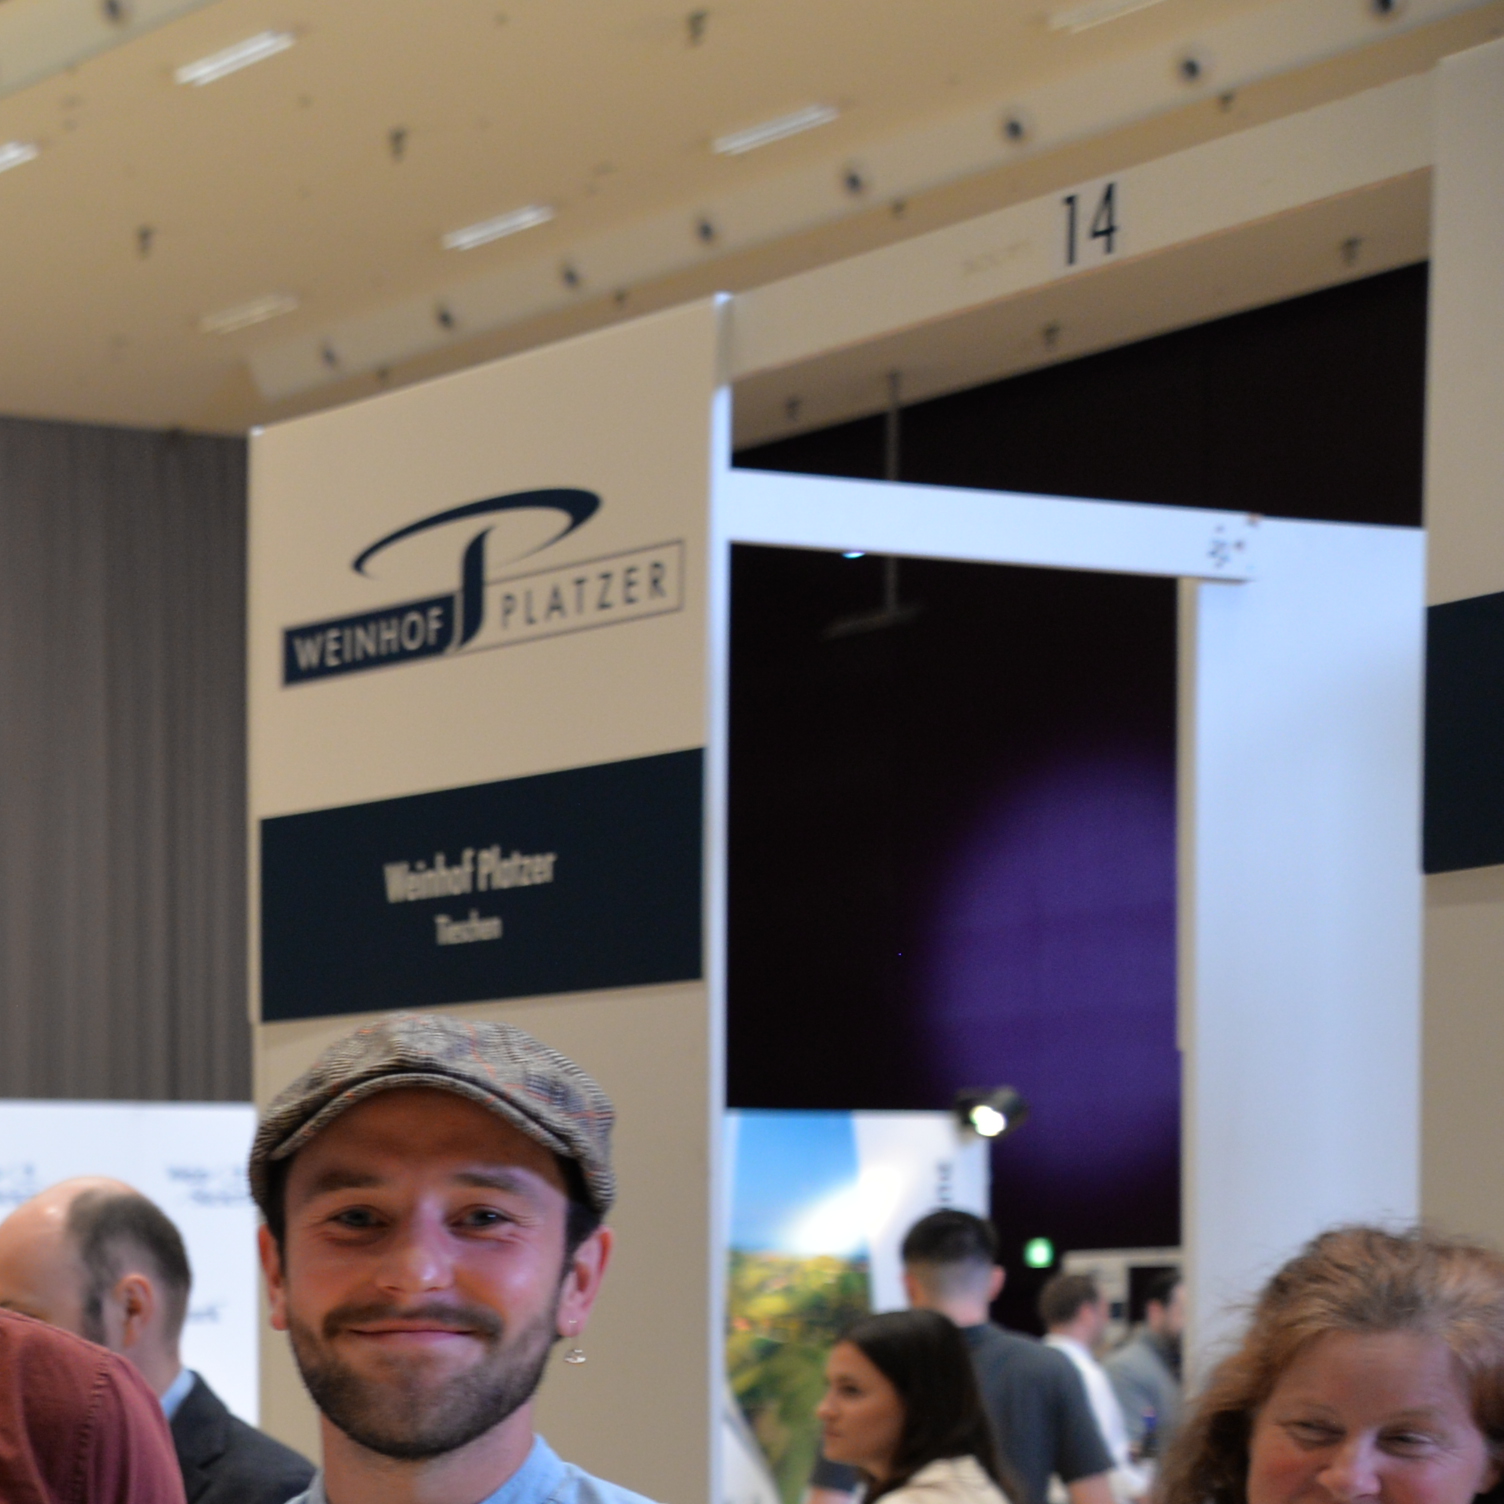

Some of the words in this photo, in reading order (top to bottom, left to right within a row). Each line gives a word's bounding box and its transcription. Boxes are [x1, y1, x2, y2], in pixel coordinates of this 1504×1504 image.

[1062, 182, 1117, 265] 14
[293, 607, 444, 672] WEINHOF
[500, 561, 667, 629] PLATZER
[383, 847, 474, 903] Weinhof
[477, 843, 558, 892] Platzer
